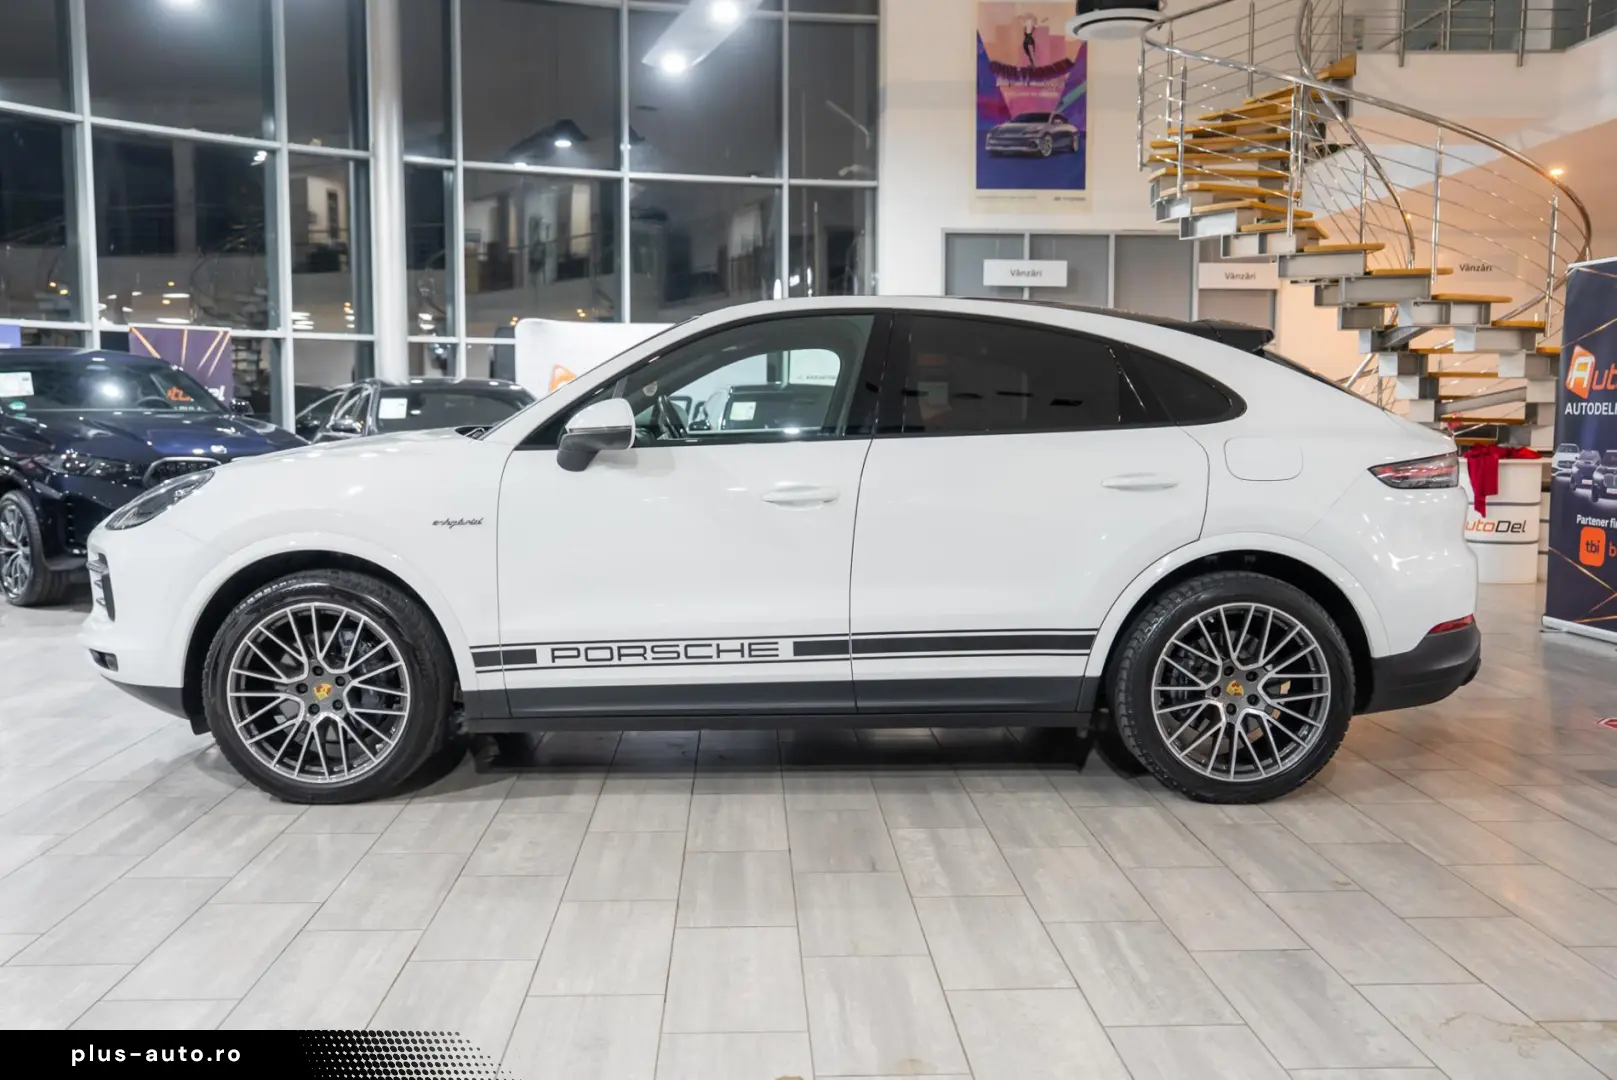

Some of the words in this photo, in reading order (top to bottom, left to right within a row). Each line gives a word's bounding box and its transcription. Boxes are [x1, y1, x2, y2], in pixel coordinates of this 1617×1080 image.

[1465, 520, 1526, 534] utoDel
[1576, 514, 1609, 528] Partener
[1585, 540, 1601, 554] tbi
[551, 642, 779, 664] PORSCHE
